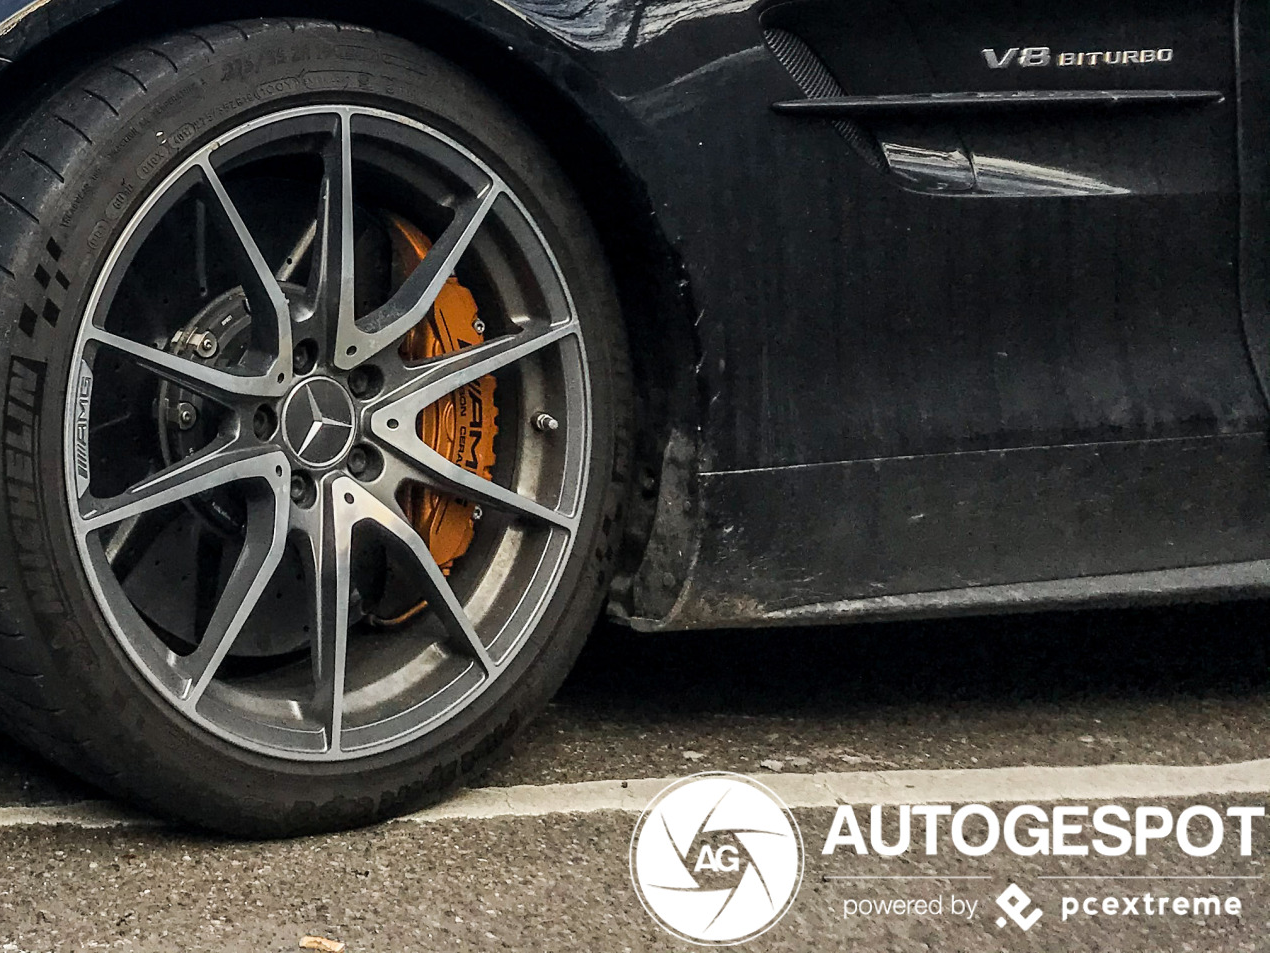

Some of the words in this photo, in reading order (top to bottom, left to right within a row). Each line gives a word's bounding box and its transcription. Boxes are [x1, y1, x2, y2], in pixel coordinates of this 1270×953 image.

[982, 46, 1051, 69] V8
[1057, 48, 1174, 66] BITURBO
[75, 376, 92, 446] AMG
[465, 396, 483, 472] AM
[454, 426, 468, 468] CERA
[5, 357, 63, 614] MICHELIN
